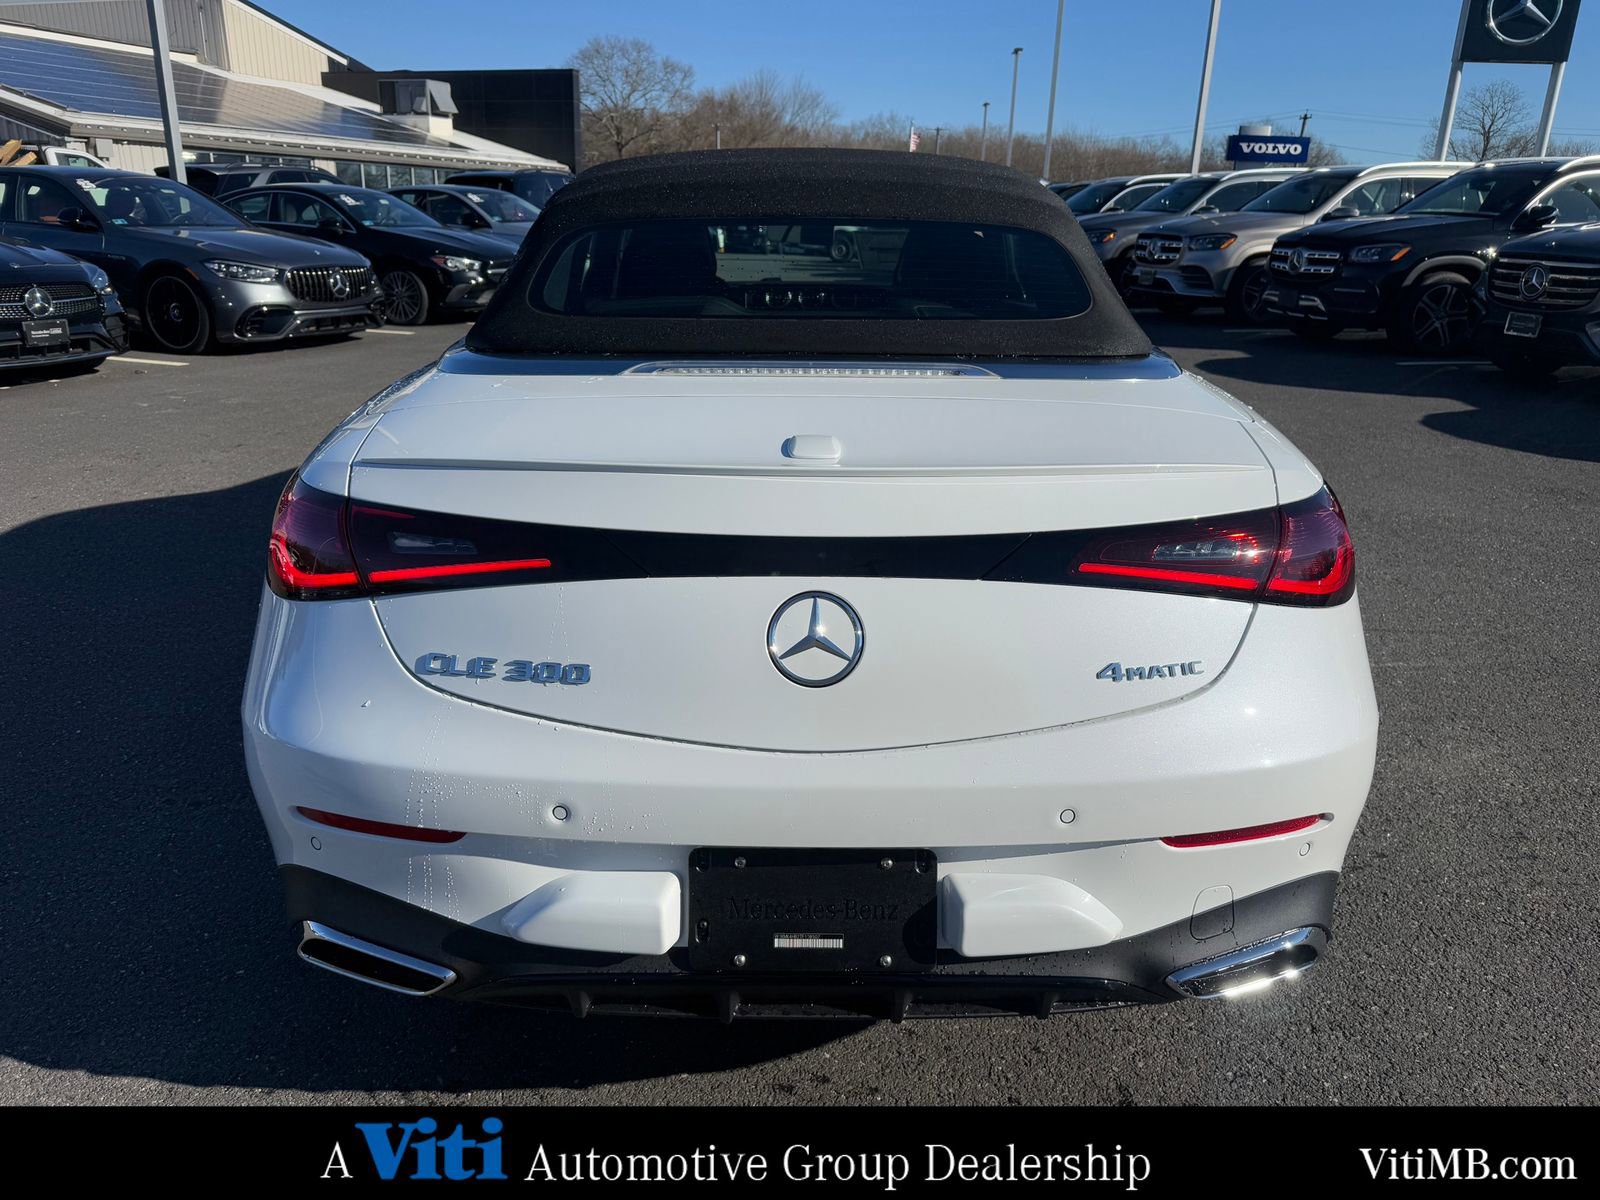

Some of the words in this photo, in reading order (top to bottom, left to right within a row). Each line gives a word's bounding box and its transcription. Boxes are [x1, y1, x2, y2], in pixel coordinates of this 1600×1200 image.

[1239, 142, 1302, 155] VOLVO
[414, 652, 498, 680] CLE
[502, 659, 592, 686] 300
[1096, 660, 1205, 682] 4MATIC
[727, 897, 899, 921] Mercedes-Benz
